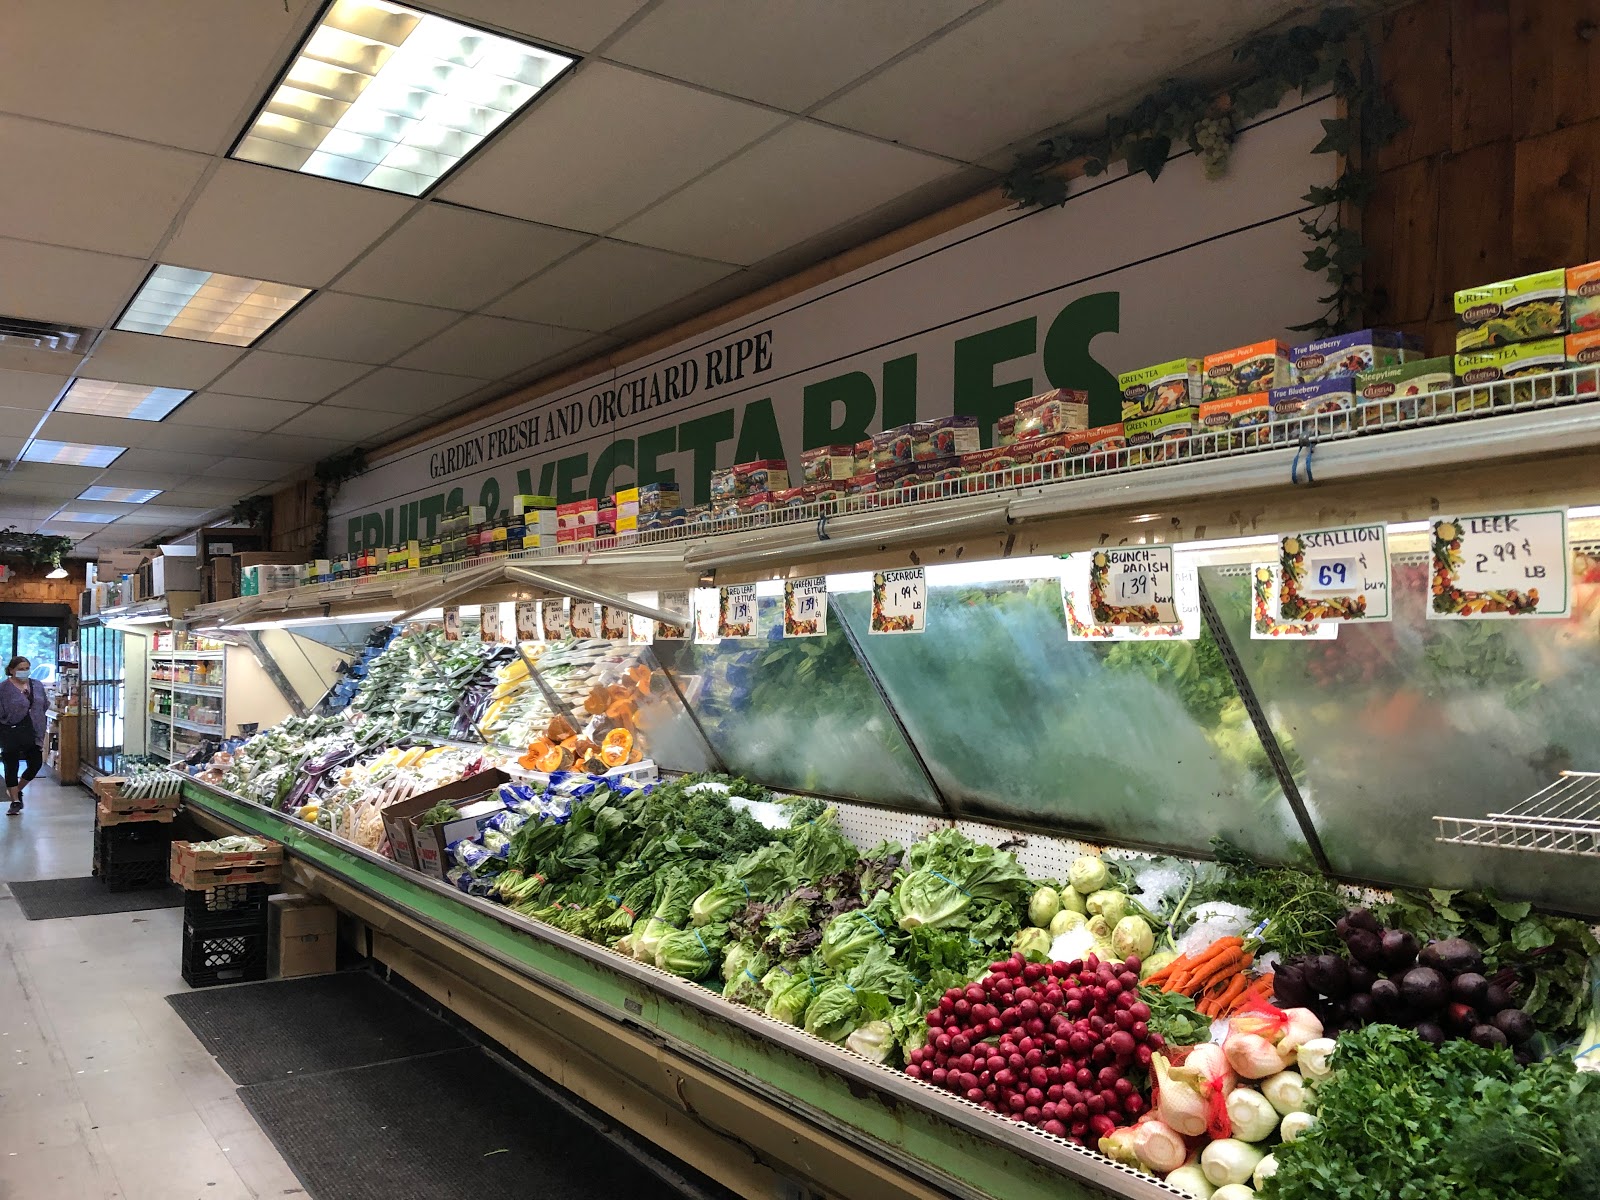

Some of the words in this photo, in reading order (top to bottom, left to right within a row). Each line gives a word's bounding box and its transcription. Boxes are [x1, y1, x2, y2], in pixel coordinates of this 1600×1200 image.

[1458, 289, 1493, 304] GREEN
[1498, 285, 1518, 296] TEA
[1465, 307, 1496, 318] CELESTIAL
[1237, 347, 1254, 356] Peach
[1294, 347, 1308, 355] True
[1309, 340, 1342, 352] Blueberry
[1458, 354, 1494, 367] GREEN
[1498, 350, 1518, 360] TEA
[1121, 373, 1144, 384] GREEN
[1145, 369, 1158, 378] TEA
[1361, 368, 1402, 382] Sleepytime
[1273, 390, 1287, 398] True
[1288, 385, 1320, 396] Blueberry
[430, 436, 484, 479] GARDEN
[487, 416, 540, 461] FRESH
[544, 402, 583, 443] AND
[588, 359, 698, 428] ORCHARD
[705, 330, 772, 390] RIPE
[1204, 402, 1234, 412] Sleepytime
[1235, 397, 1253, 407] Peach
[1126, 421, 1148, 431] GREEN
[1150, 418, 1163, 427] TEA
[1013, 443, 1033, 452] Cranberry
[1034, 440, 1046, 449] Apple
[963, 453, 981, 461] Cranberry
[982, 450, 994, 458] Apple
[1471, 515, 1520, 534] LEEK
[1305, 528, 1380, 548] SCALLION
[886, 569, 923, 582] ESCAROLE
[1318, 562, 1347, 587] 69
[1525, 565, 1546, 579] LB
[794, 579, 812, 589] GREEN
[813, 577, 826, 586] LEAF
[1121, 575, 1147, 599] 1.39
[1364, 578, 1386, 591] bun
[729, 587, 740, 595] RED
[741, 585, 753, 594] LEAF
[804, 585, 827, 595] LETTUCE
[734, 593, 756, 603] LETTUCE
[1154, 592, 1175, 604] bun
[913, 601, 921, 609] LB
